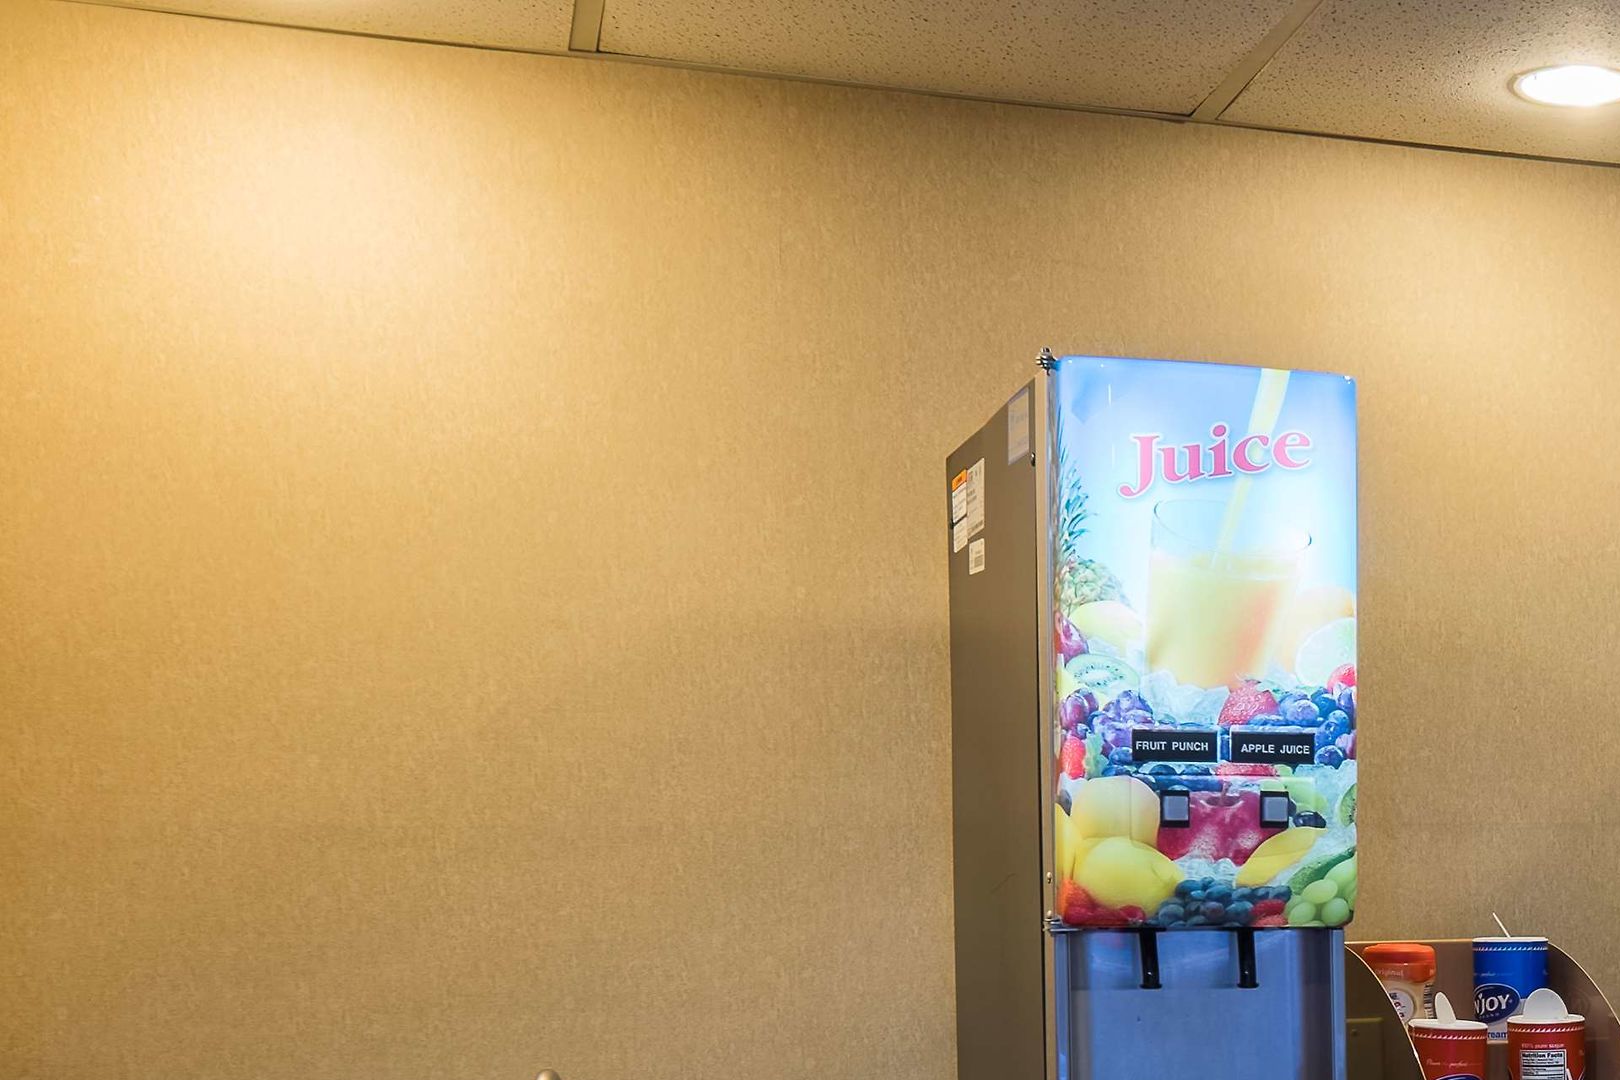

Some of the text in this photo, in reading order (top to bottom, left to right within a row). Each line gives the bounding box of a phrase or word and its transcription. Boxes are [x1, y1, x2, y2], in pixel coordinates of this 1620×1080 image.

[1118, 423, 1311, 498] Juice
[1135, 741, 1209, 751] FRUIT PUNCH
[1240, 743, 1310, 755] APPLE JUICE
